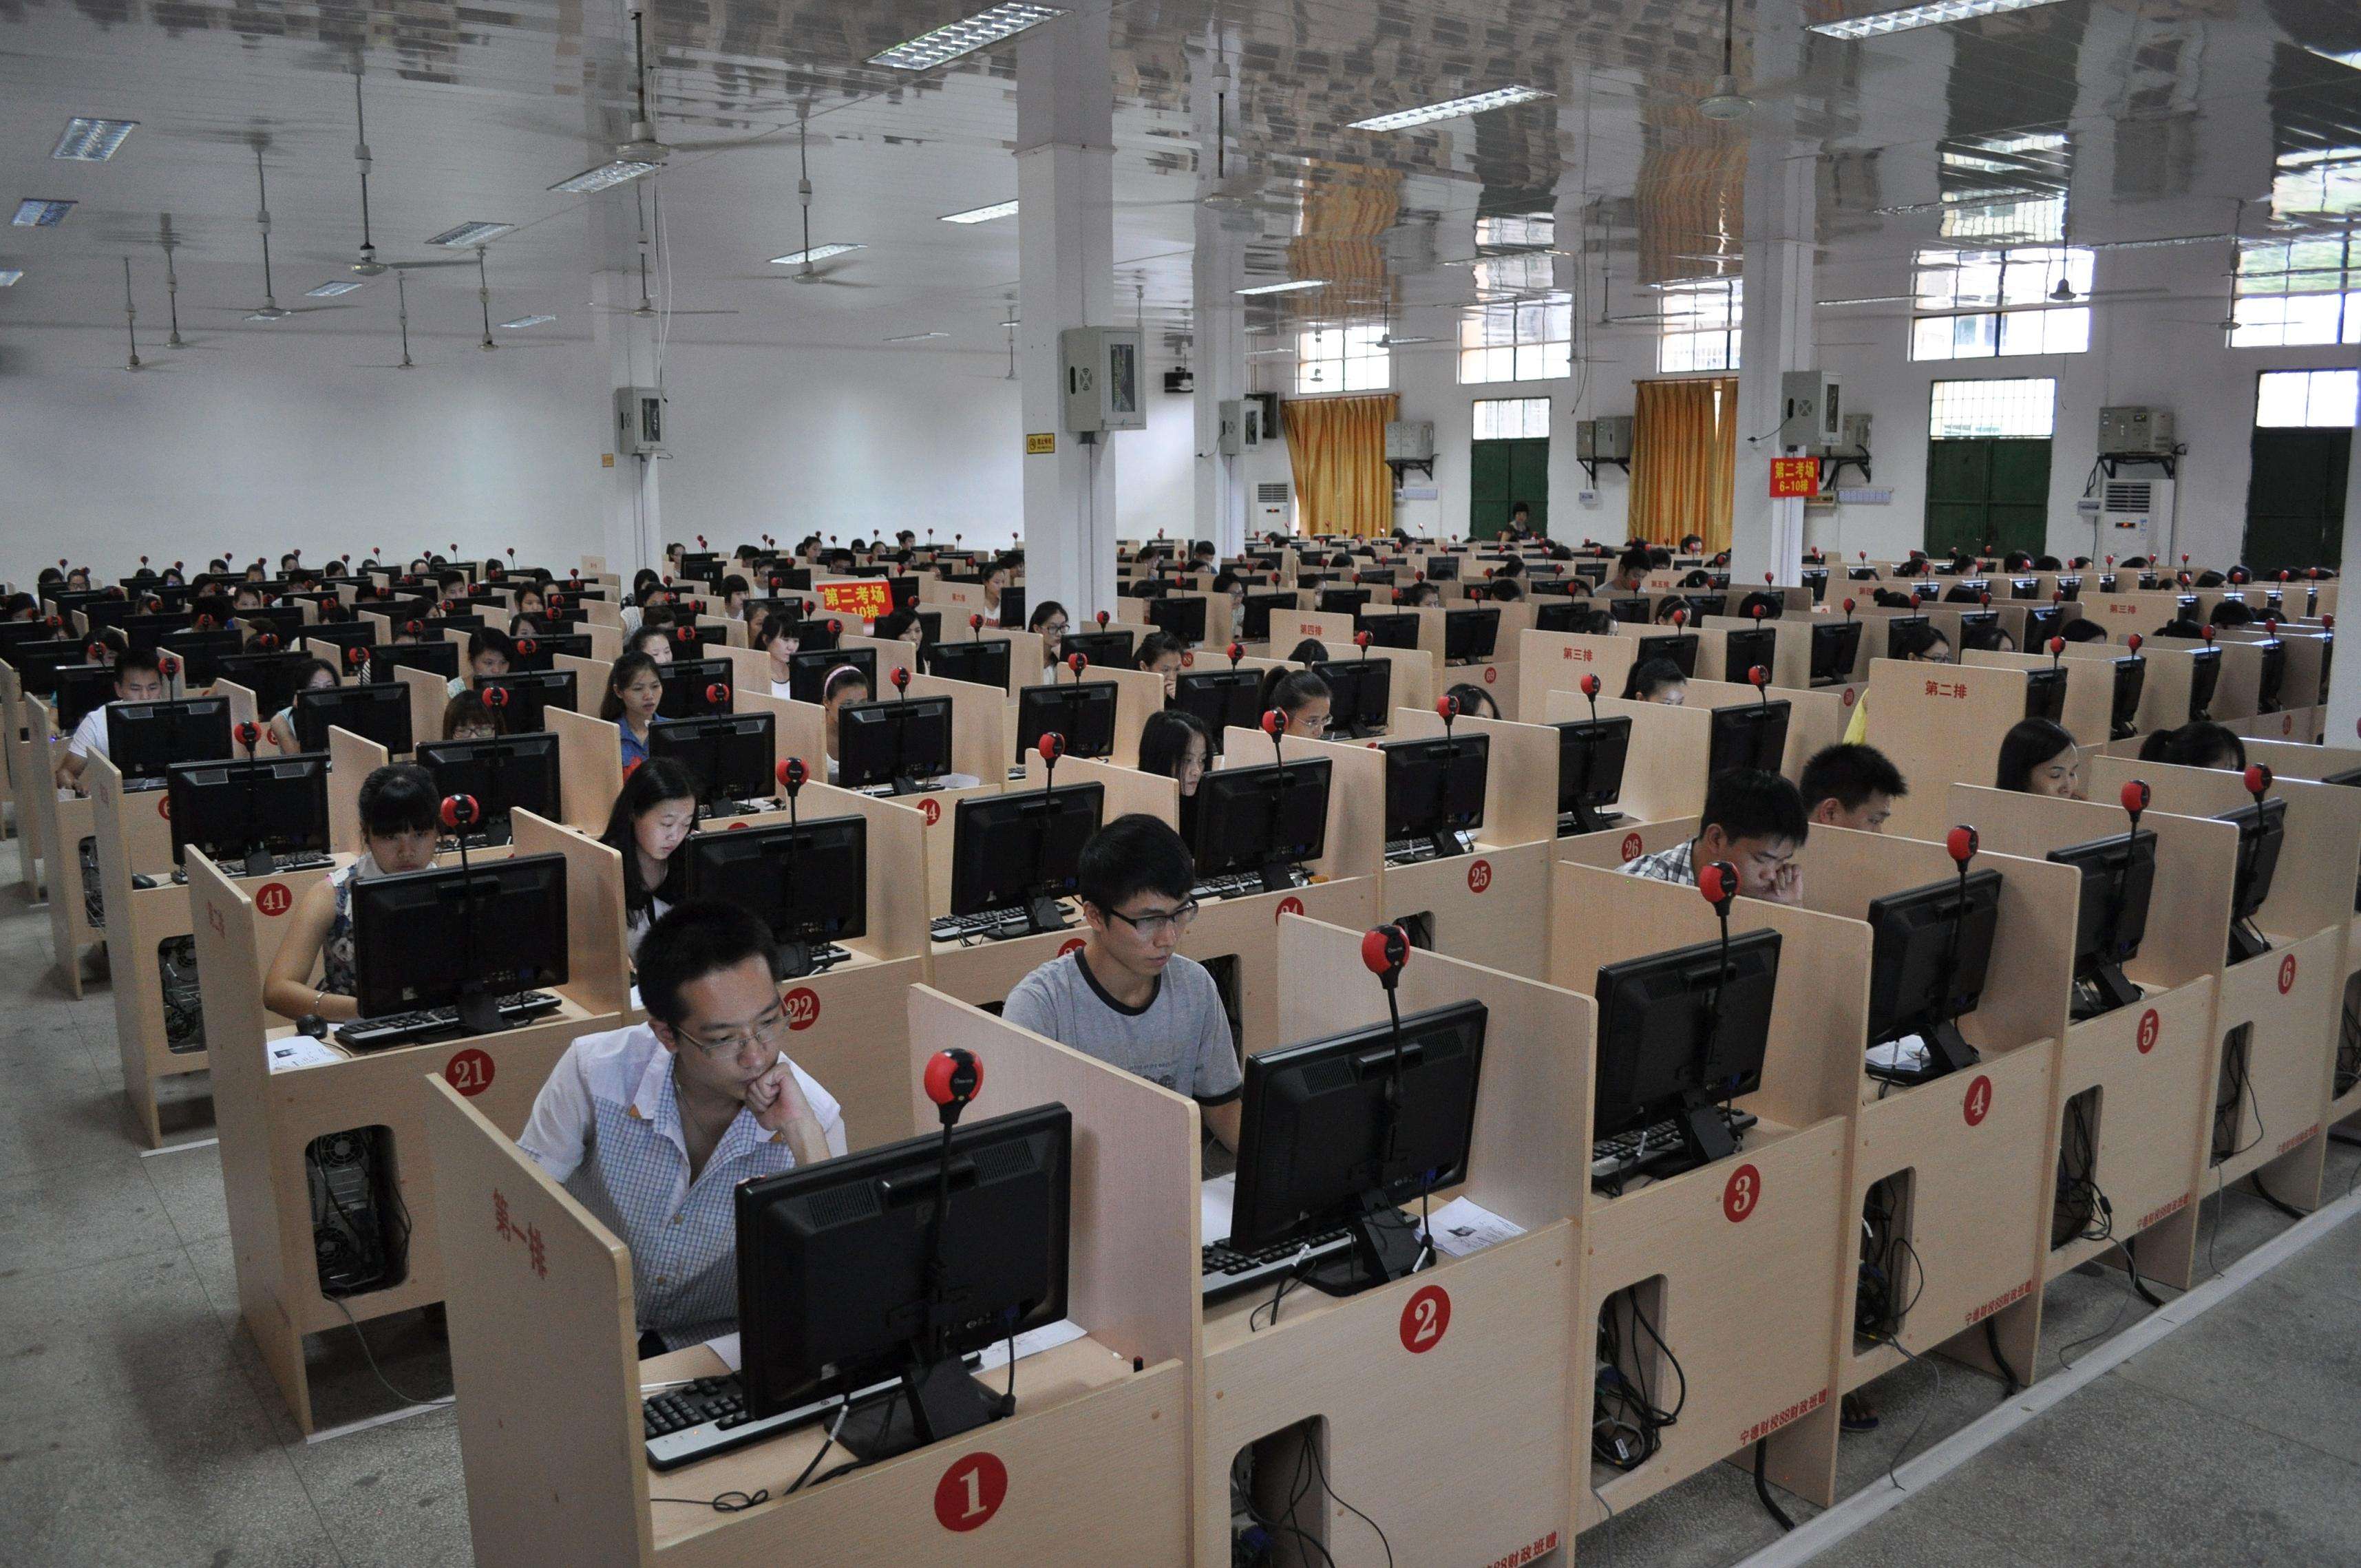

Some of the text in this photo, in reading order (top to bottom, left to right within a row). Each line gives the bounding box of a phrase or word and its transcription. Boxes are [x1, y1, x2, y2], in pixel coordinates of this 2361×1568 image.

[1775, 460, 1814, 478] 第二考场
[1779, 479, 1809, 492] 6-10排
[825, 585, 885, 606] 第二考场
[2109, 604, 2137, 614] 第三排
[1300, 624, 1323, 635] 第四排
[1563, 647, 1594, 661] 第三排
[1925, 680, 1967, 699] 第二排
[1625, 838, 1639, 859] 26
[1472, 866, 1487, 888] 25
[263, 889, 287, 910] 41
[2283, 961, 2291, 987] 6
[787, 995, 814, 1023] 22
[2142, 1018, 2154, 1043] 5
[454, 1057, 486, 1088] 21
[1971, 1084, 1985, 1116] 4
[1733, 1176, 1752, 1214] 3
[1413, 1297, 1438, 1343] 2
[1740, 1388, 1828, 1445] 宁德财校88财政班赠
[959, 1468, 988, 1519] 1
